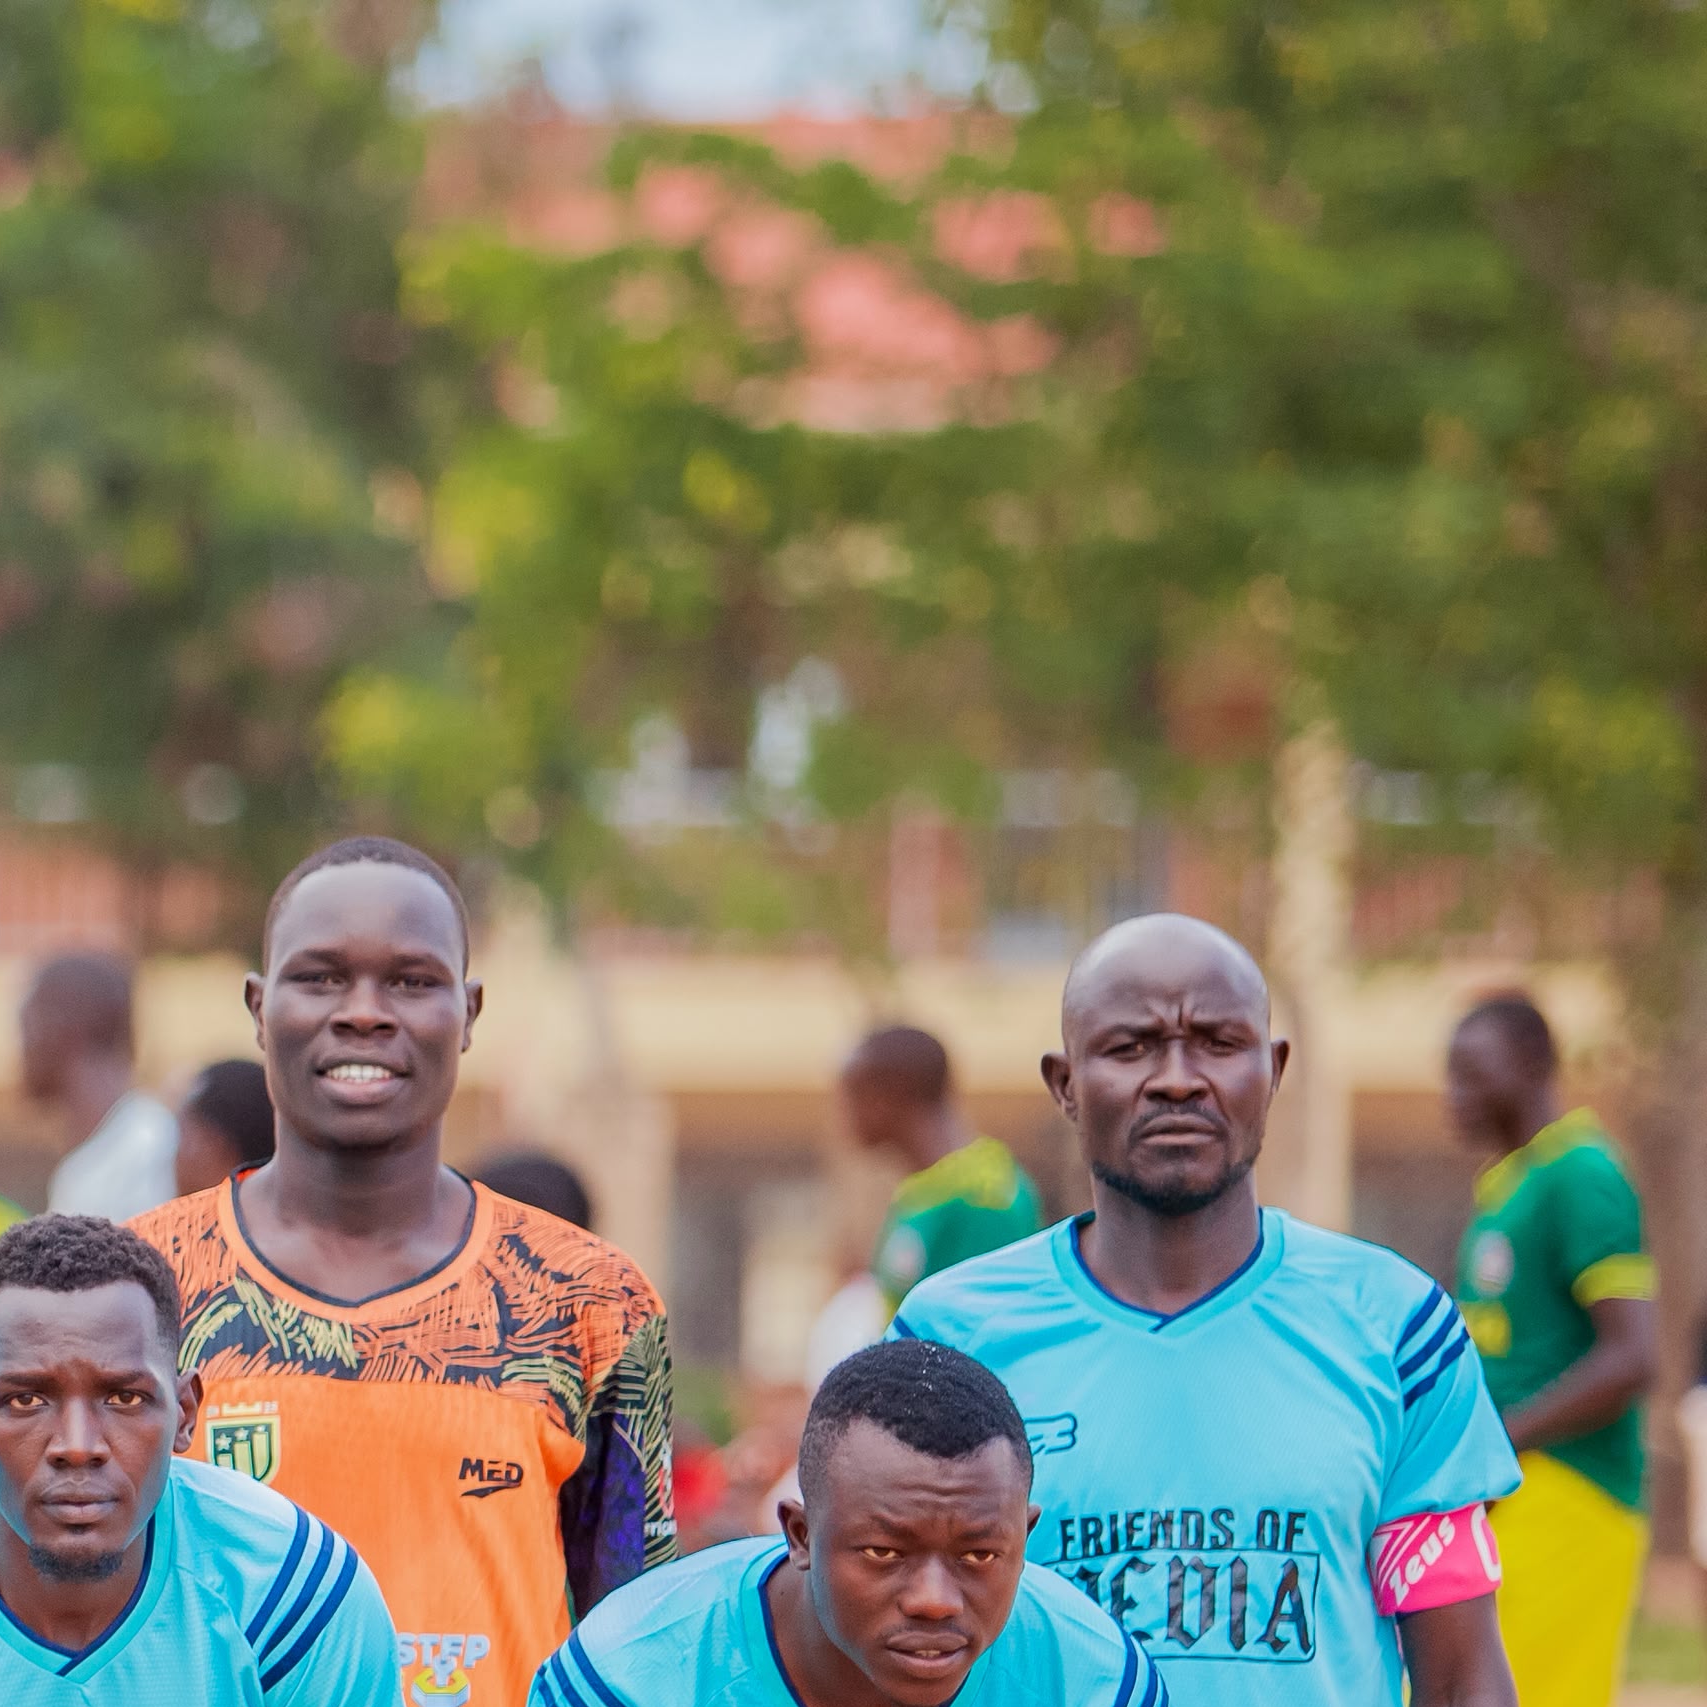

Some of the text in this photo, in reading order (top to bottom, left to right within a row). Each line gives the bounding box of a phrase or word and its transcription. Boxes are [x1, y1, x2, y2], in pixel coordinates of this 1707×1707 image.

[458, 1457, 524, 1484] MED
[1059, 1508, 1307, 1561] FRIENDS OF
